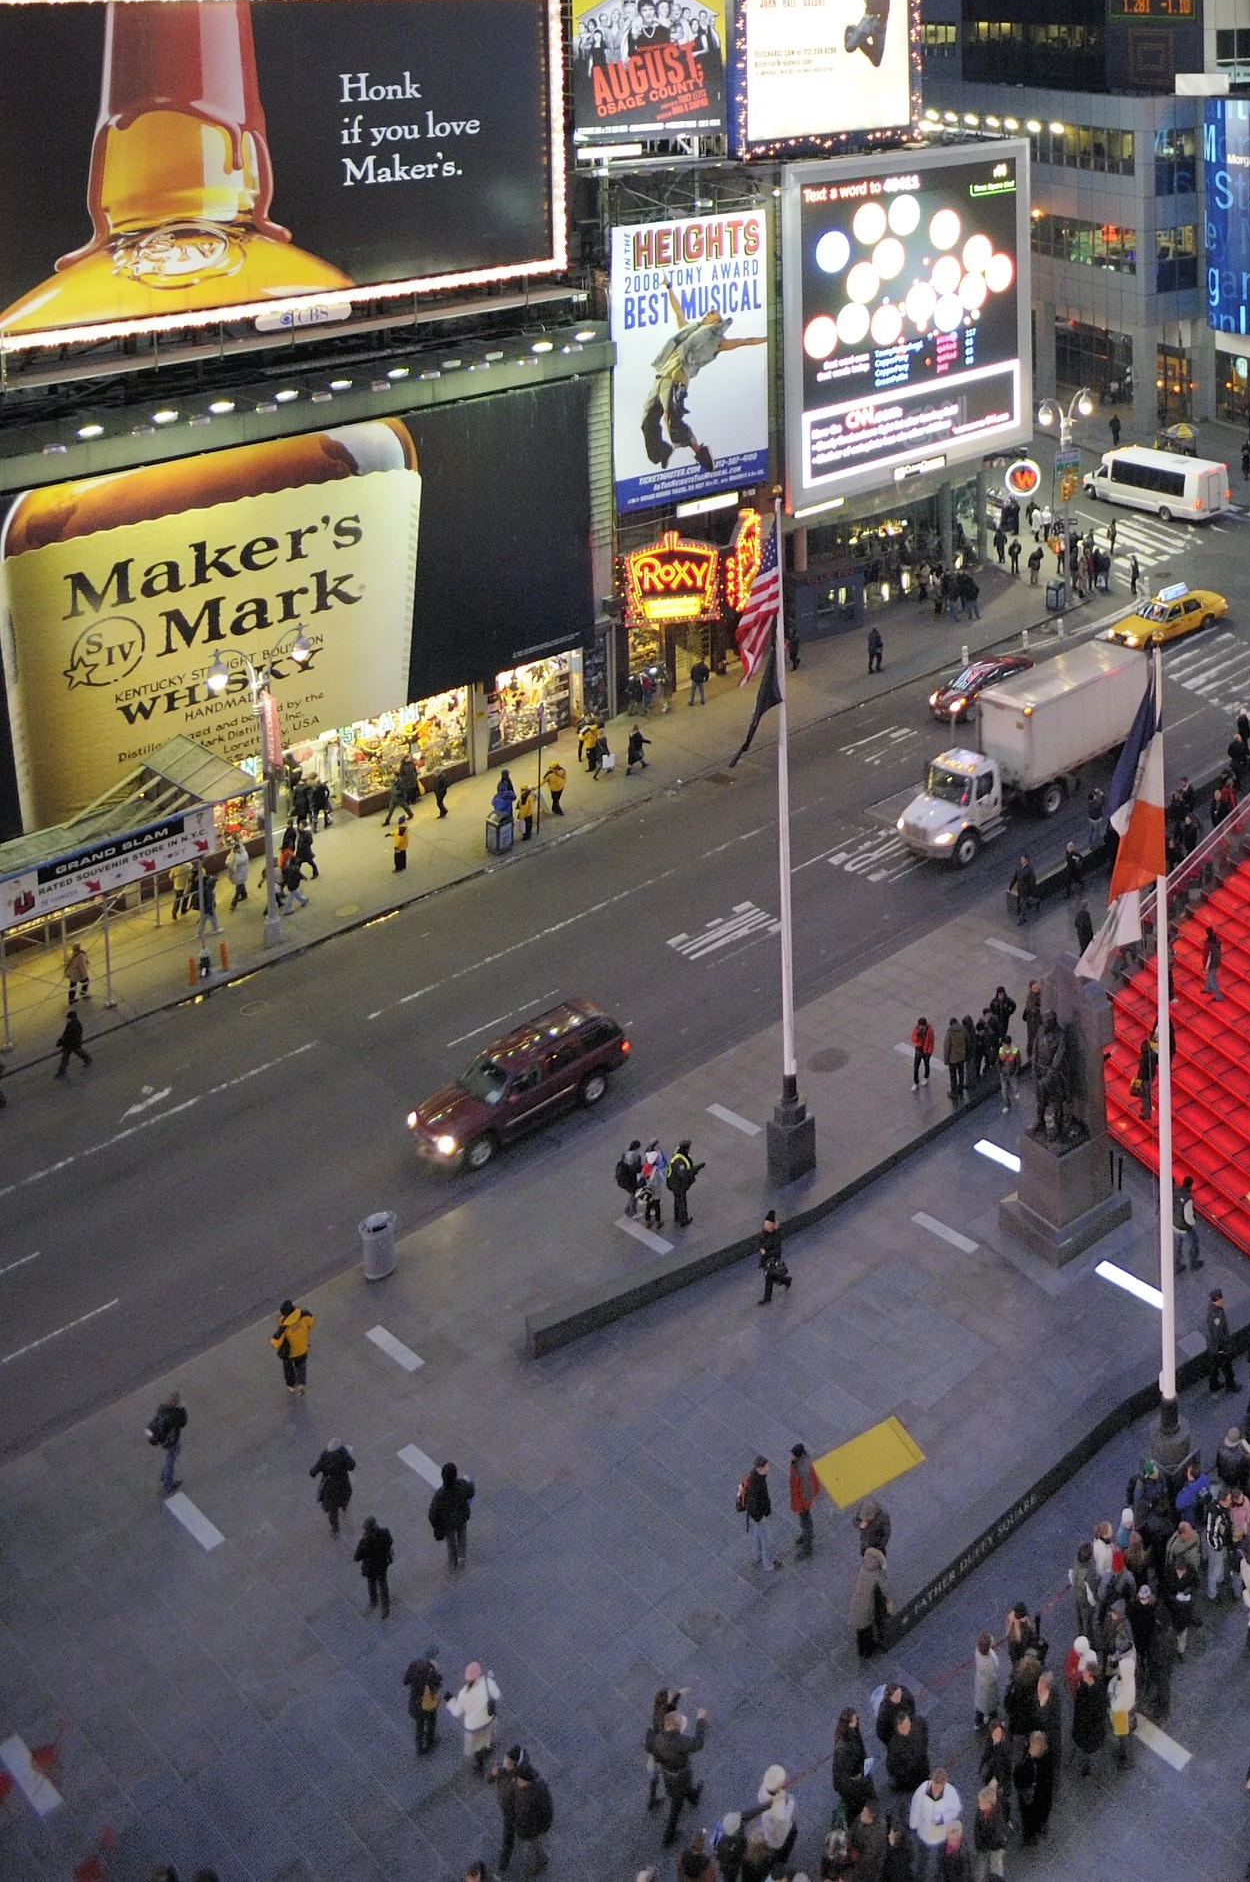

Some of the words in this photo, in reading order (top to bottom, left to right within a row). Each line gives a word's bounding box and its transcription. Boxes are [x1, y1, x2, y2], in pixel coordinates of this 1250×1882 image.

[339, 71, 422, 103] Honk
[592, 42, 704, 105] AUGUST:
[596, 93, 645, 117] OSAGE
[650, 77, 704, 102] COUNTY
[341, 115, 363, 144] if
[370, 124, 421, 146] you
[425, 110, 480, 138] love
[342, 152, 463, 186] Maker's.
[633, 218, 761, 271] HEIGHTS
[624, 272, 660, 295] 2008
[668, 266, 702, 287] TONY
[711, 259, 759, 282] AWARD
[297, 305, 329, 323] CBS
[624, 292, 669, 330] BEST
[681, 279, 761, 319] MUSICAL
[62, 514, 363, 621] Maker's
[634, 557, 709, 590] ROXY
[726, 557, 735, 607] ROXY
[156, 570, 364, 658] Mark
[86, 633, 102, 656] S
[106, 640, 136, 666] IV
[114, 673, 187, 704] KENTUCKY
[191, 652, 257, 681] STIGHT
[262, 633, 324, 660] BOUON
[116, 647, 324, 726] WHISKY
[184, 690, 261, 722] HANDMAD
[215, 719, 239, 732] and
[287, 698, 303, 713] by
[305, 692, 325, 704] the
[293, 715, 321, 732] USA
[227, 722, 264, 740] Distill
[267, 695, 280, 761] WELCOME
[38, 879, 73, 896] RATED
[76, 858, 130, 883] SOUVENIR
[132, 845, 164, 862] STORE
[167, 839, 179, 848] IN
[55, 845, 117, 875] GRAND
[122, 828, 170, 850] SLAM
